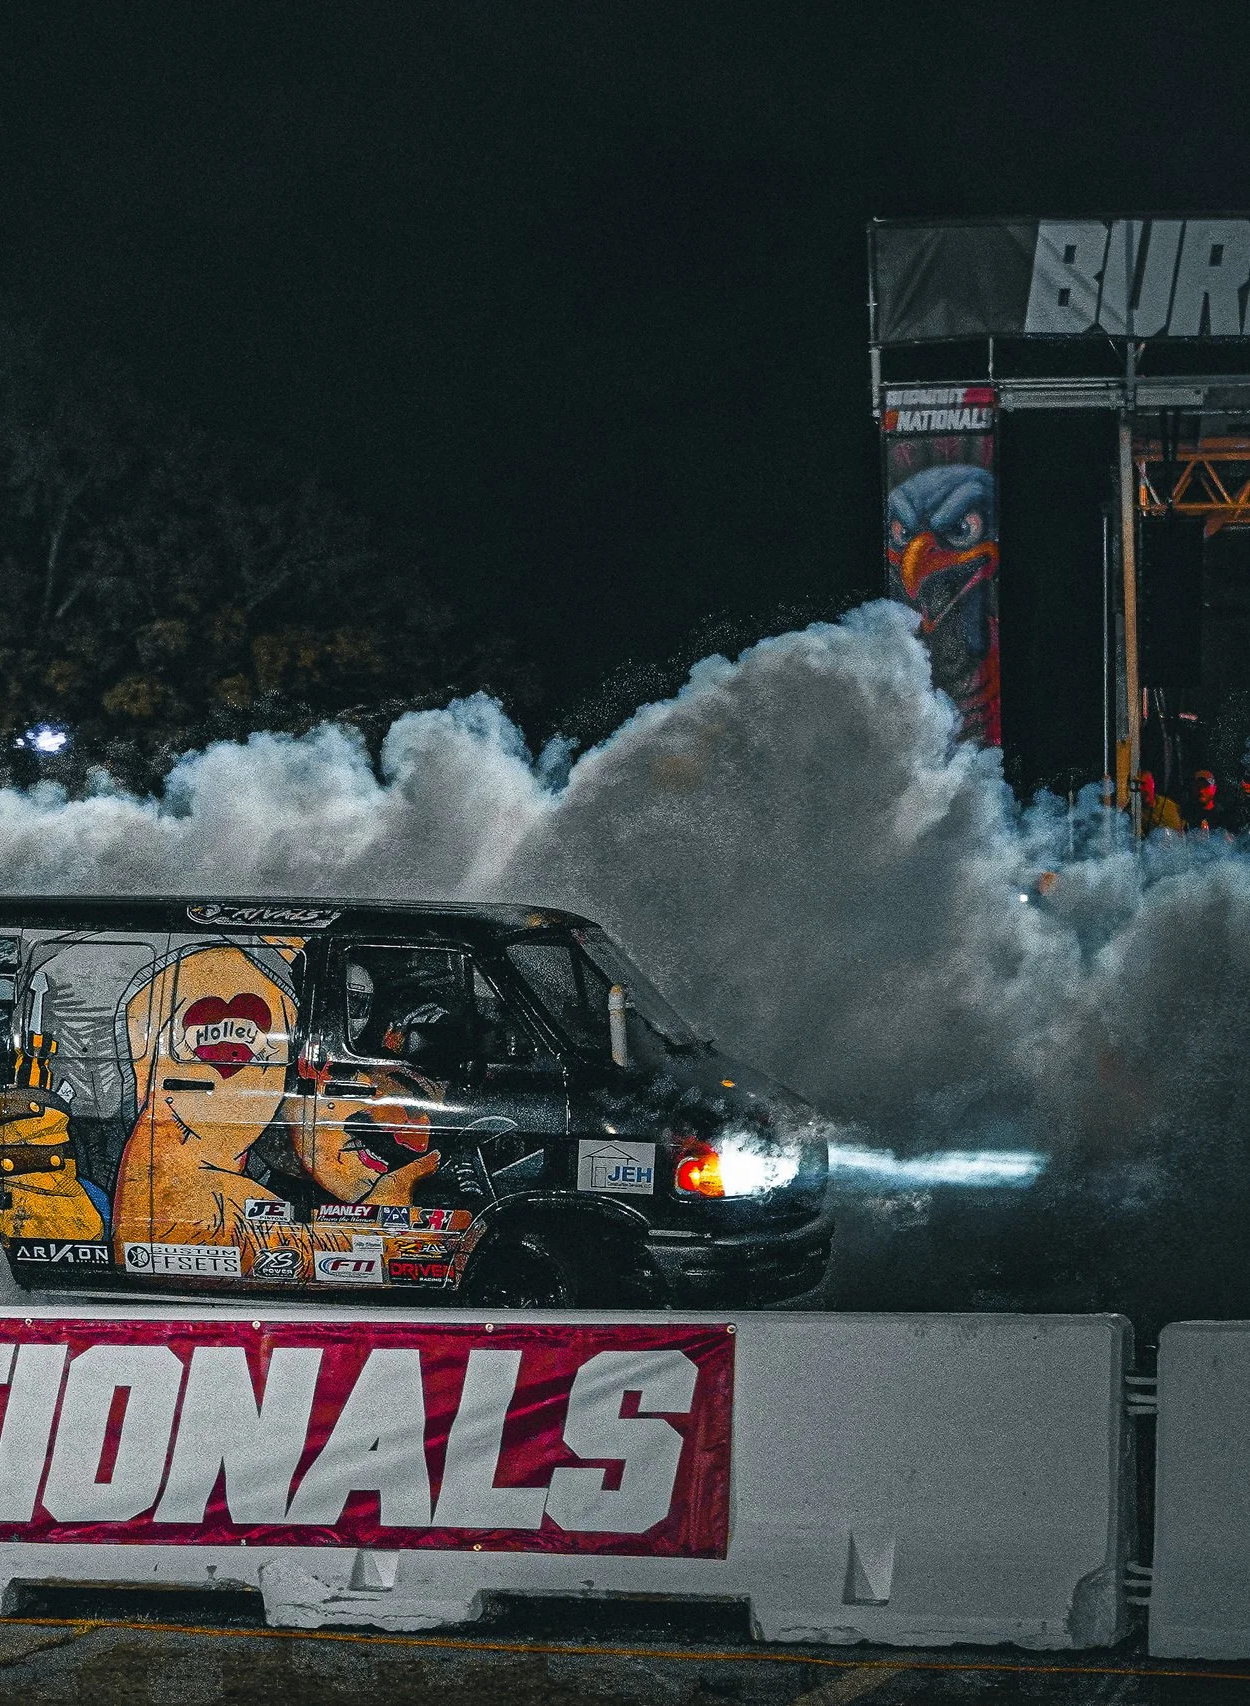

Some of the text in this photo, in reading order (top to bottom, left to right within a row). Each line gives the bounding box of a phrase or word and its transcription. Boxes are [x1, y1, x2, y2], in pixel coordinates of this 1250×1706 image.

[1024, 219, 1250, 337] BUR
[897, 407, 993, 432] NATIONALS
[196, 1021, 258, 1046] Holley
[608, 1166, 653, 1183] JEH
[248, 1201, 286, 1217] JE
[319, 1205, 372, 1216] MANLEY
[152, 1246, 237, 1256] CUSTOM
[257, 1252, 293, 1268] XS
[390, 1262, 455, 1279] DRIVEN
